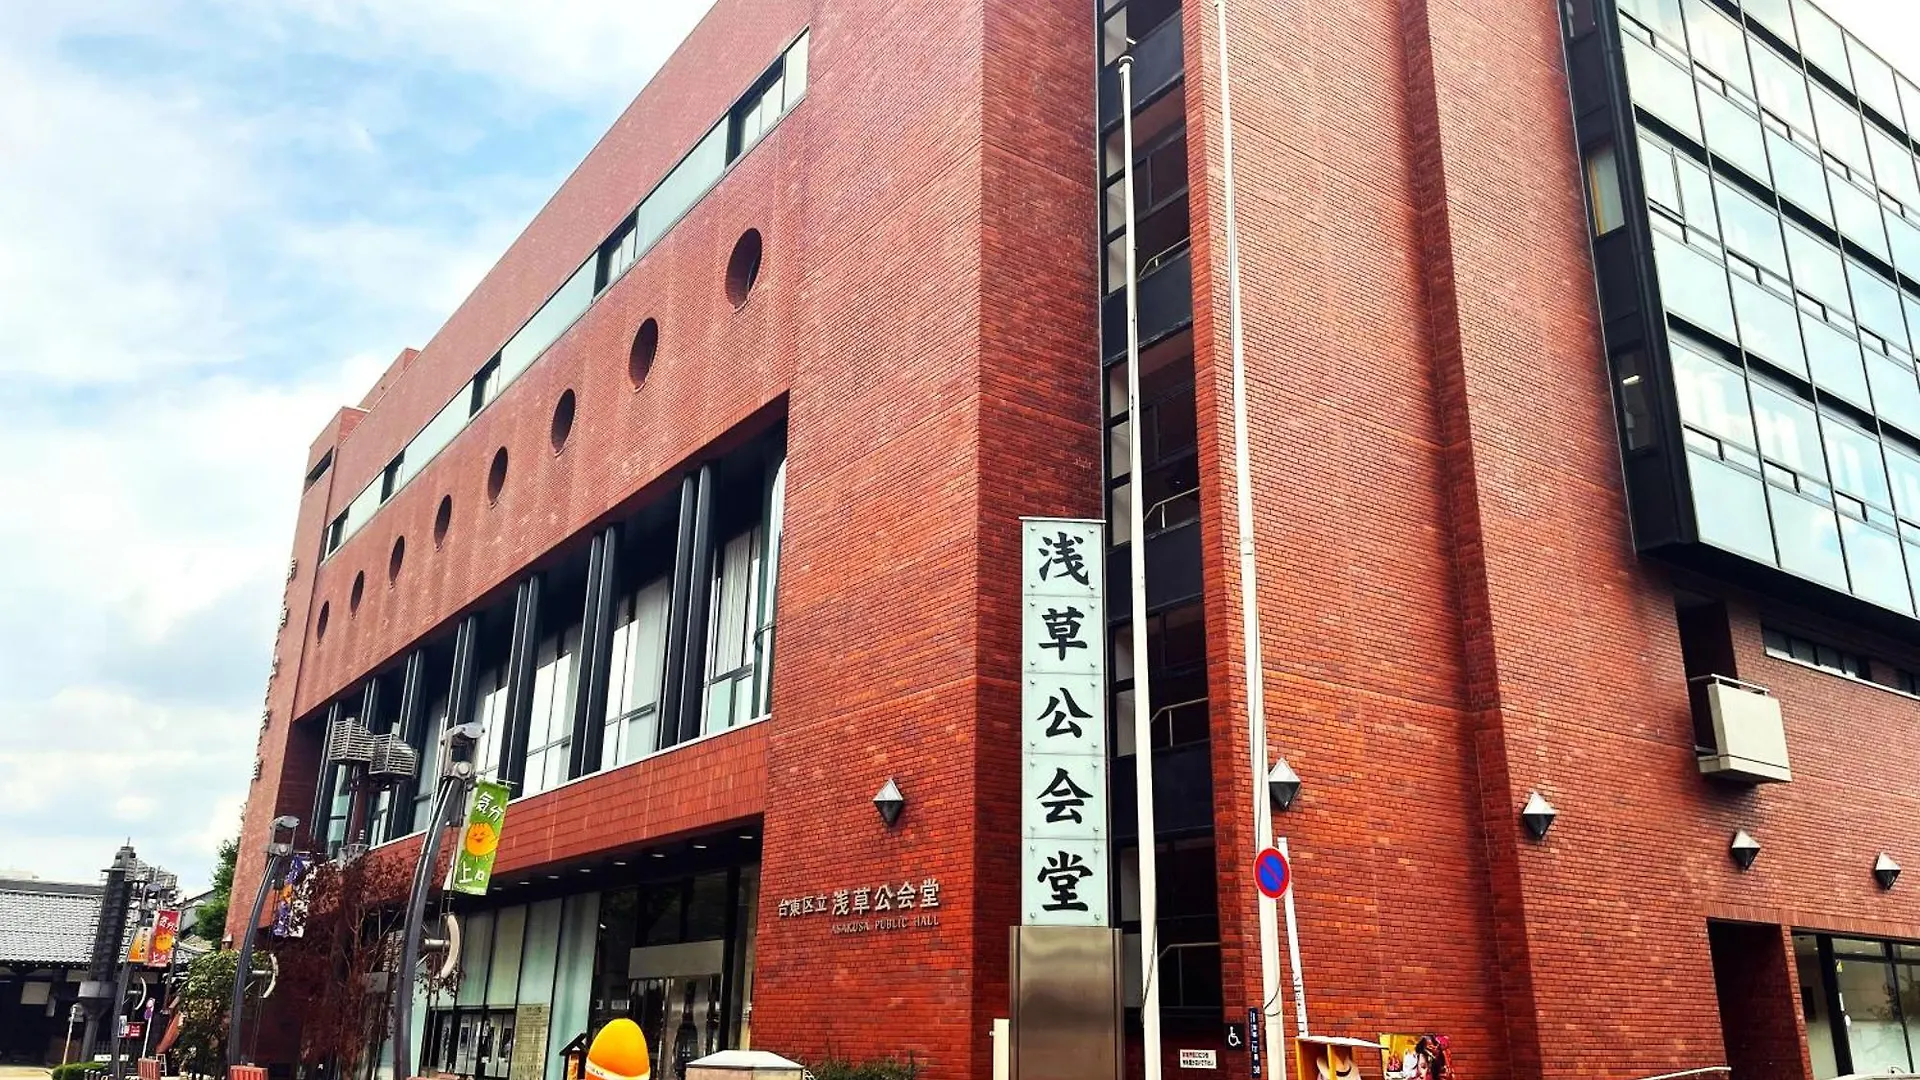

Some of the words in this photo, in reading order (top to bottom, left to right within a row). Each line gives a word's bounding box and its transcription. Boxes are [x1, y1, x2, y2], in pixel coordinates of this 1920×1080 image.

[1037, 532, 1094, 912] 浅草公会堂
[832, 878, 940, 916] 浅草公会堂
[832, 921, 870, 934] ASAKUSA
[875, 917, 908, 930] PUBLIC
[914, 915, 940, 927] HALL
